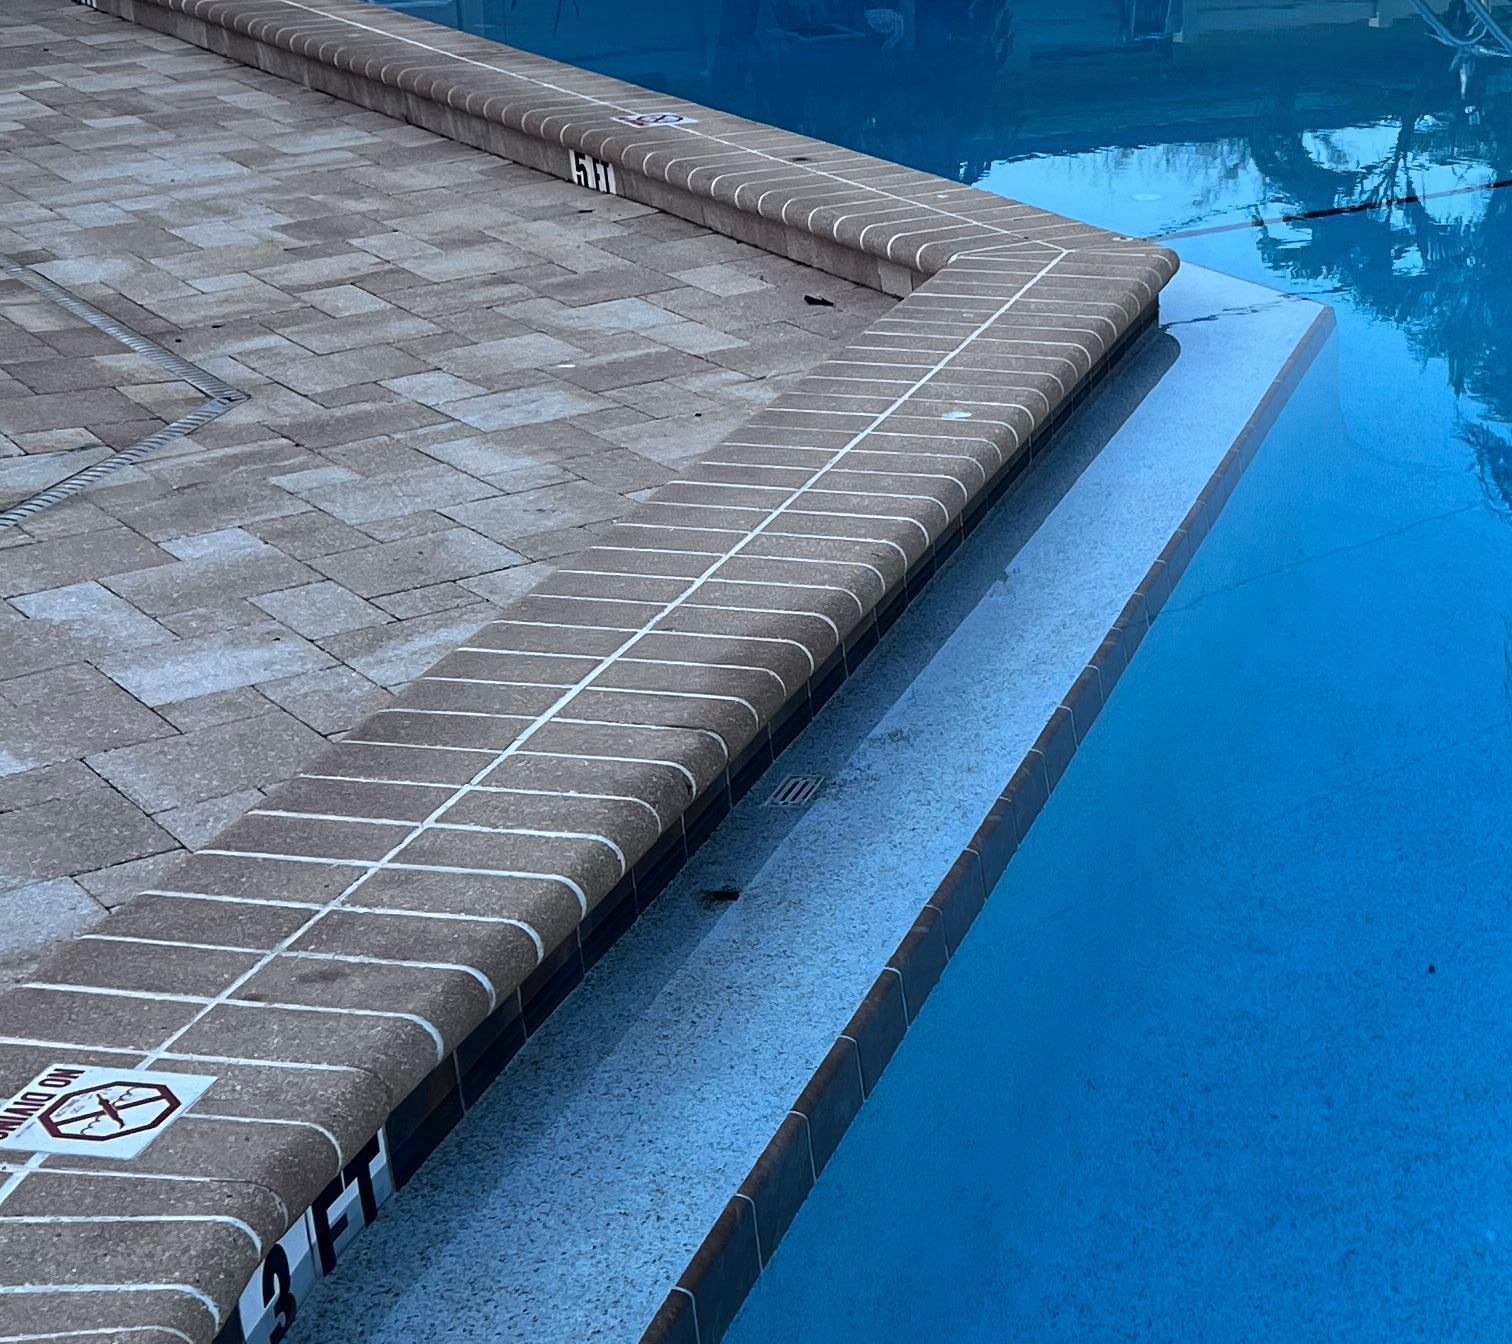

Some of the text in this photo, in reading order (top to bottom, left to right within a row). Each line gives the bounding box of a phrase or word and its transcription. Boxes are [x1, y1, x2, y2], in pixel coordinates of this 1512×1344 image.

[574, 151, 610, 194] 5 FT
[0, 1068, 85, 1141] NO DIVIN
[311, 1138, 380, 1277] FT
